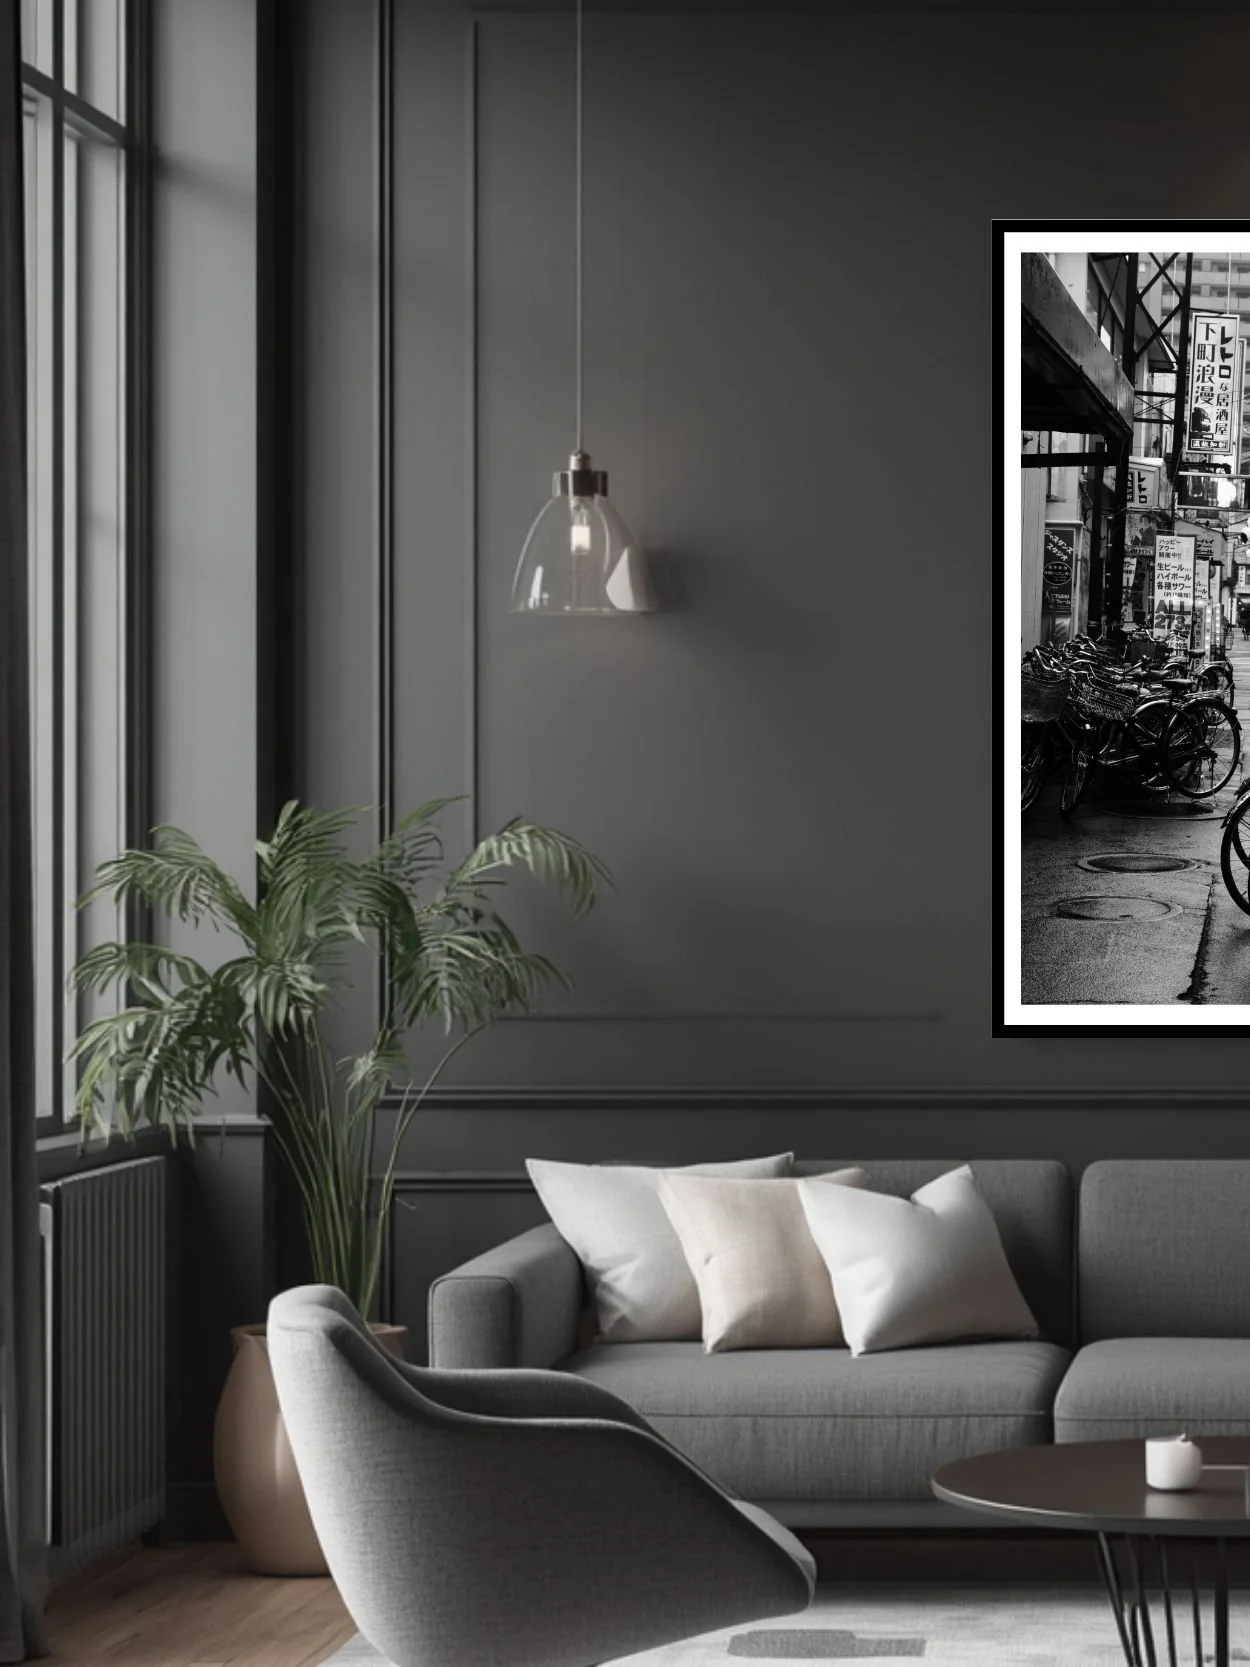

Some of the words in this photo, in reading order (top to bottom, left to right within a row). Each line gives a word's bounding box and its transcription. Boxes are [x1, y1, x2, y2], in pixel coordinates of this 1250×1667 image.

[1194, 321, 1218, 406] 下町浪漫
[1214, 325, 1234, 436] レトロな居酒屋
[1137, 471, 1148, 504] レトロ
[1156, 572, 1192, 581] ハイボール
[1156, 581, 1191, 590] 各種サワー
[1155, 600, 1191, 616] ALL
